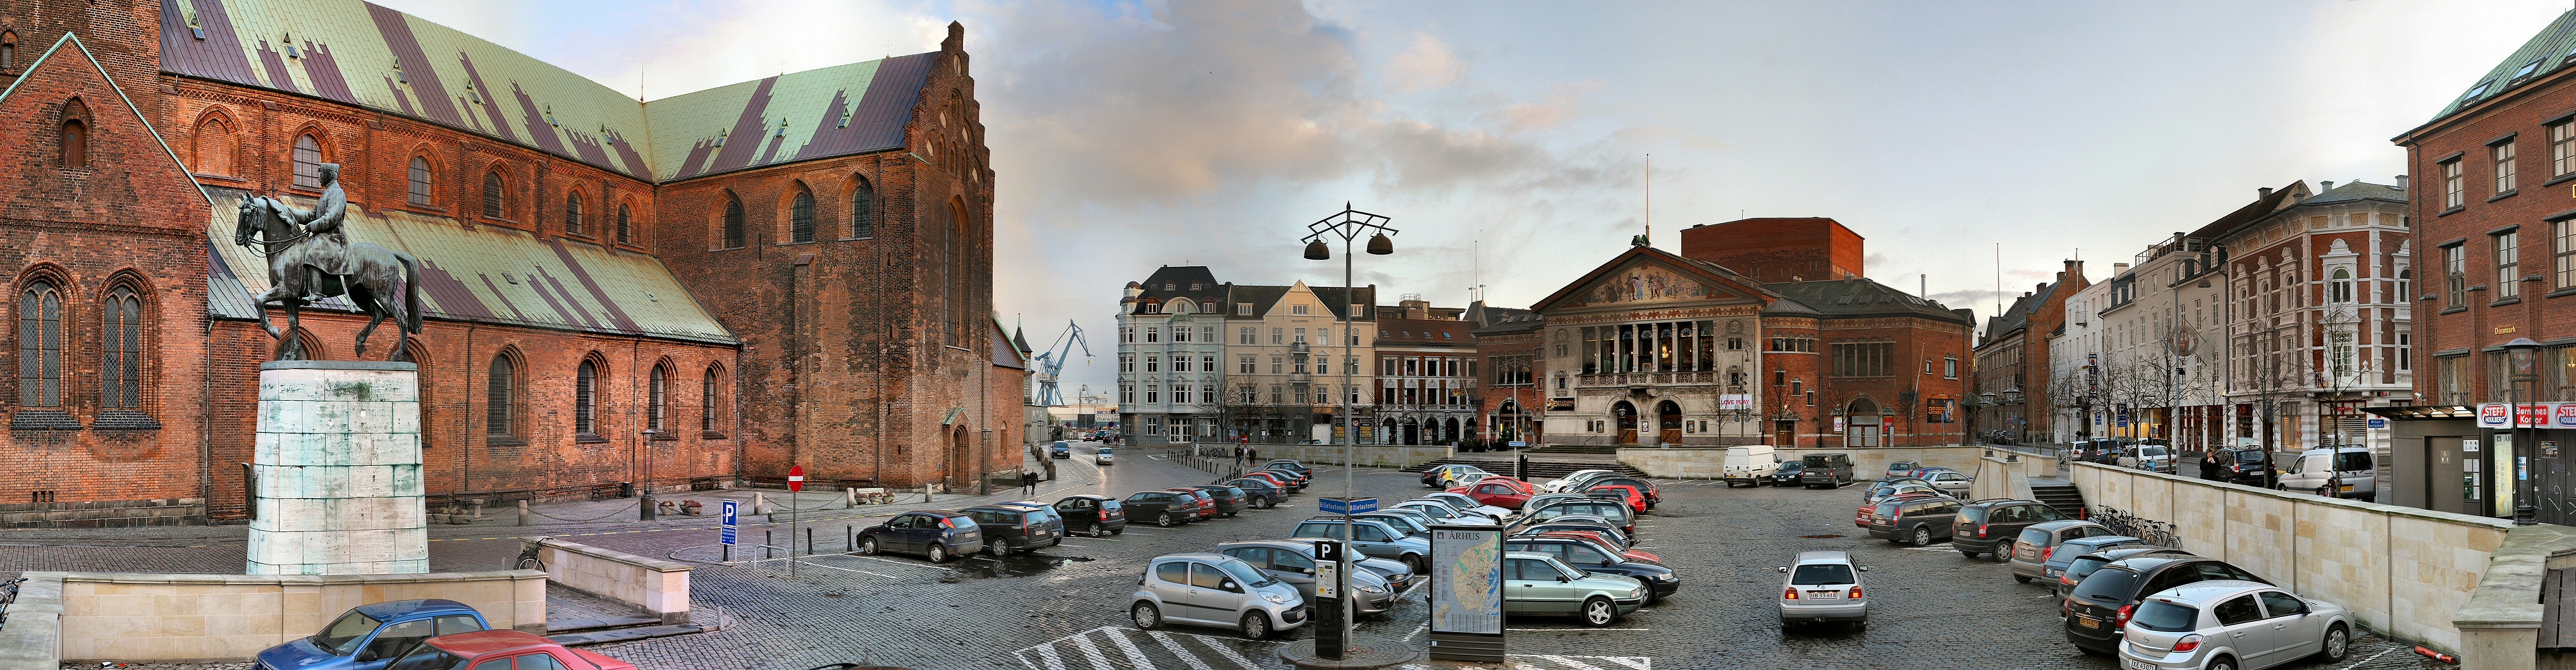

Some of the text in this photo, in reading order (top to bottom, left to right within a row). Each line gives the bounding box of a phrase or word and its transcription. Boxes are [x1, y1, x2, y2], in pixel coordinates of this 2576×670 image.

[2494, 326, 2516, 335] Danmark
[2485, 406, 2504, 417] STEFF
[2516, 406, 2547, 415] Børnnes
[1320, 501, 1346, 511] Billetautomat
[1349, 502, 1377, 511] Billetautomat
[725, 504, 734, 523] P
[1449, 530, 1480, 540] ÅRHUS
[1322, 544, 1331, 557] P
